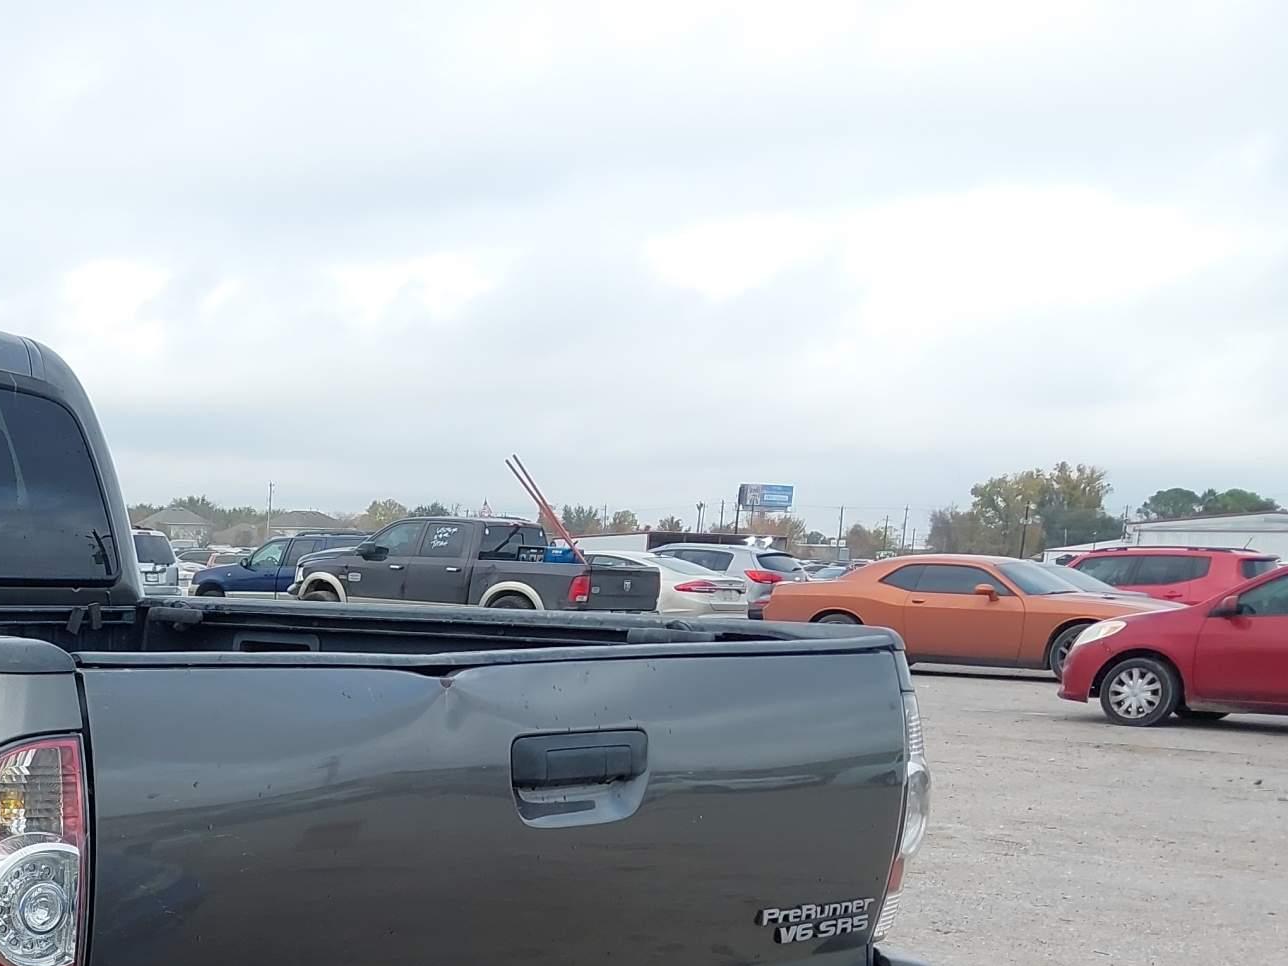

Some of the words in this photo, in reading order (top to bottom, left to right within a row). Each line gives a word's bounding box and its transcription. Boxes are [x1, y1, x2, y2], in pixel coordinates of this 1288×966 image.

[760, 898, 875, 927] PreRunner
[777, 923, 813, 944] V6
[816, 914, 869, 938] SR5
